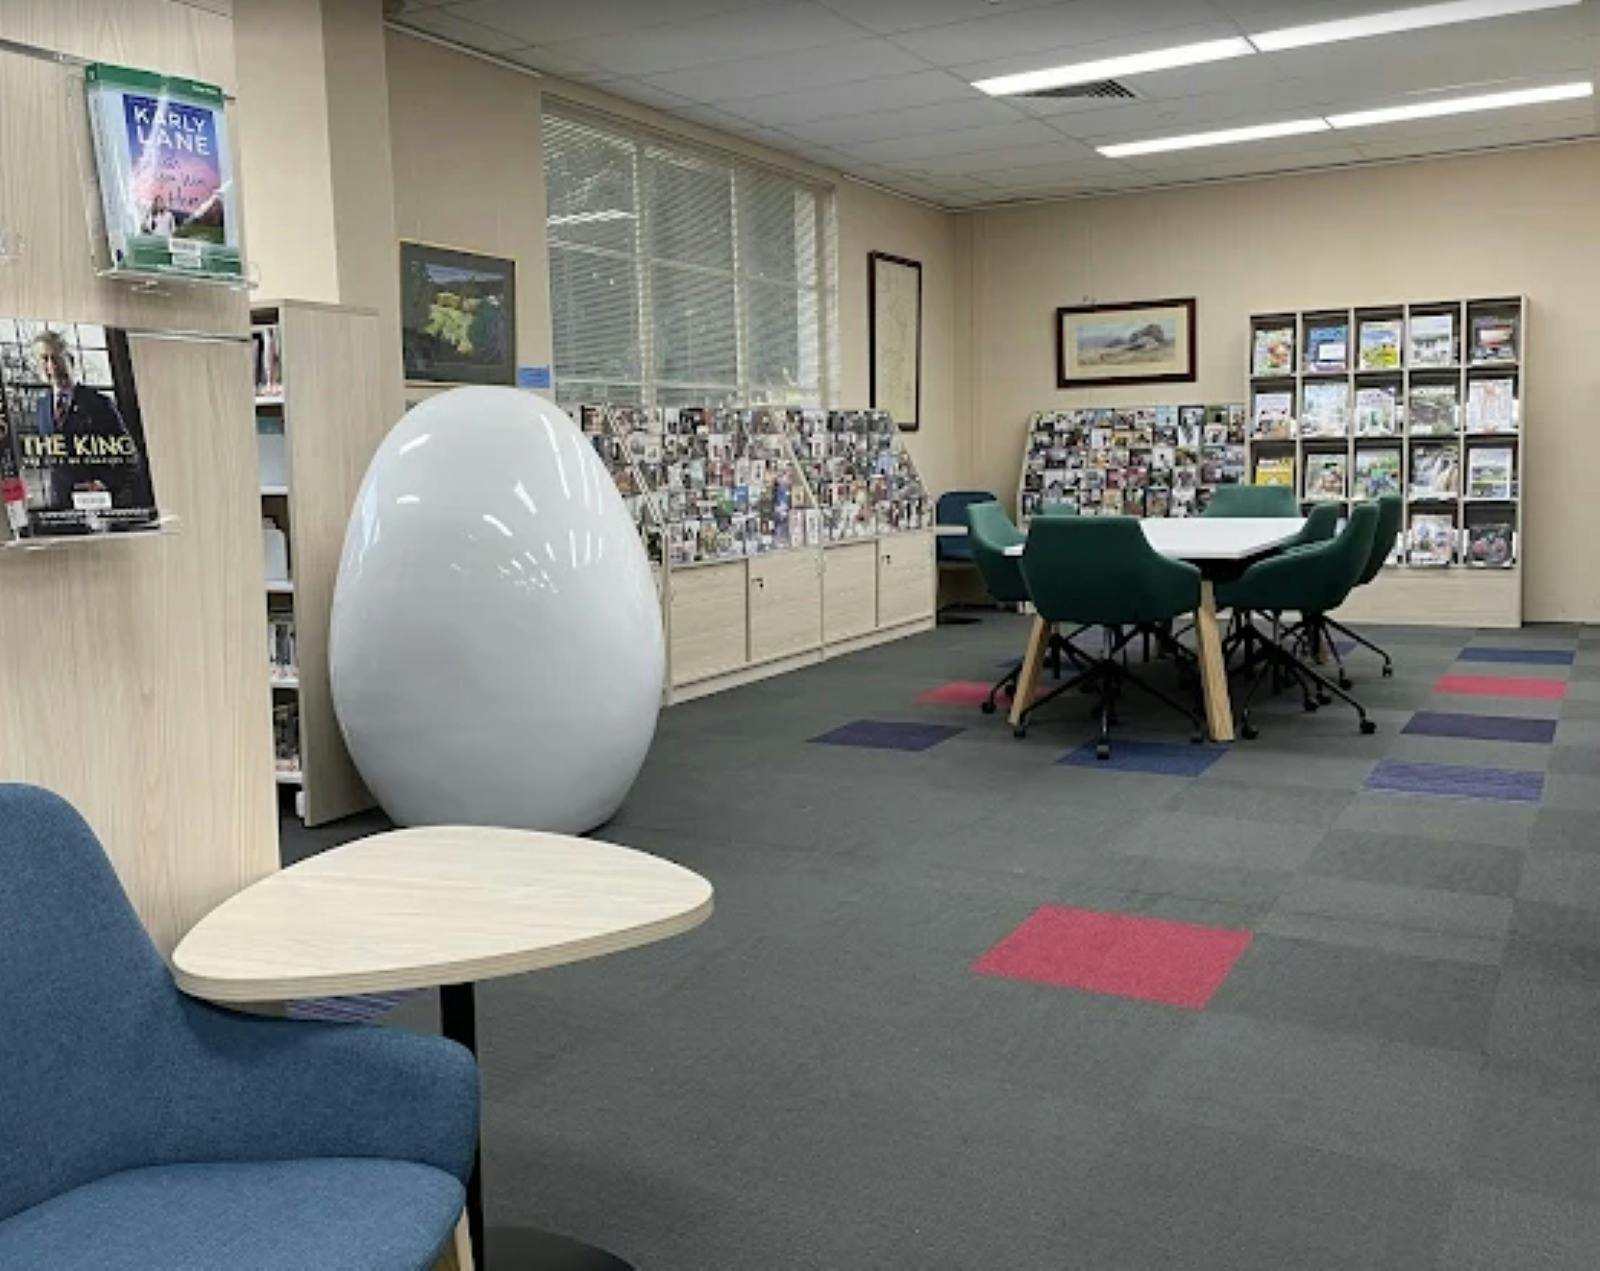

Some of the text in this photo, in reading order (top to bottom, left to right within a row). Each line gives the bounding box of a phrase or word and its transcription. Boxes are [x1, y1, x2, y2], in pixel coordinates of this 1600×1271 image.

[134, 106, 206, 132] KARLY
[137, 125, 211, 155] LANE
[20, 433, 136, 456] THE KING
